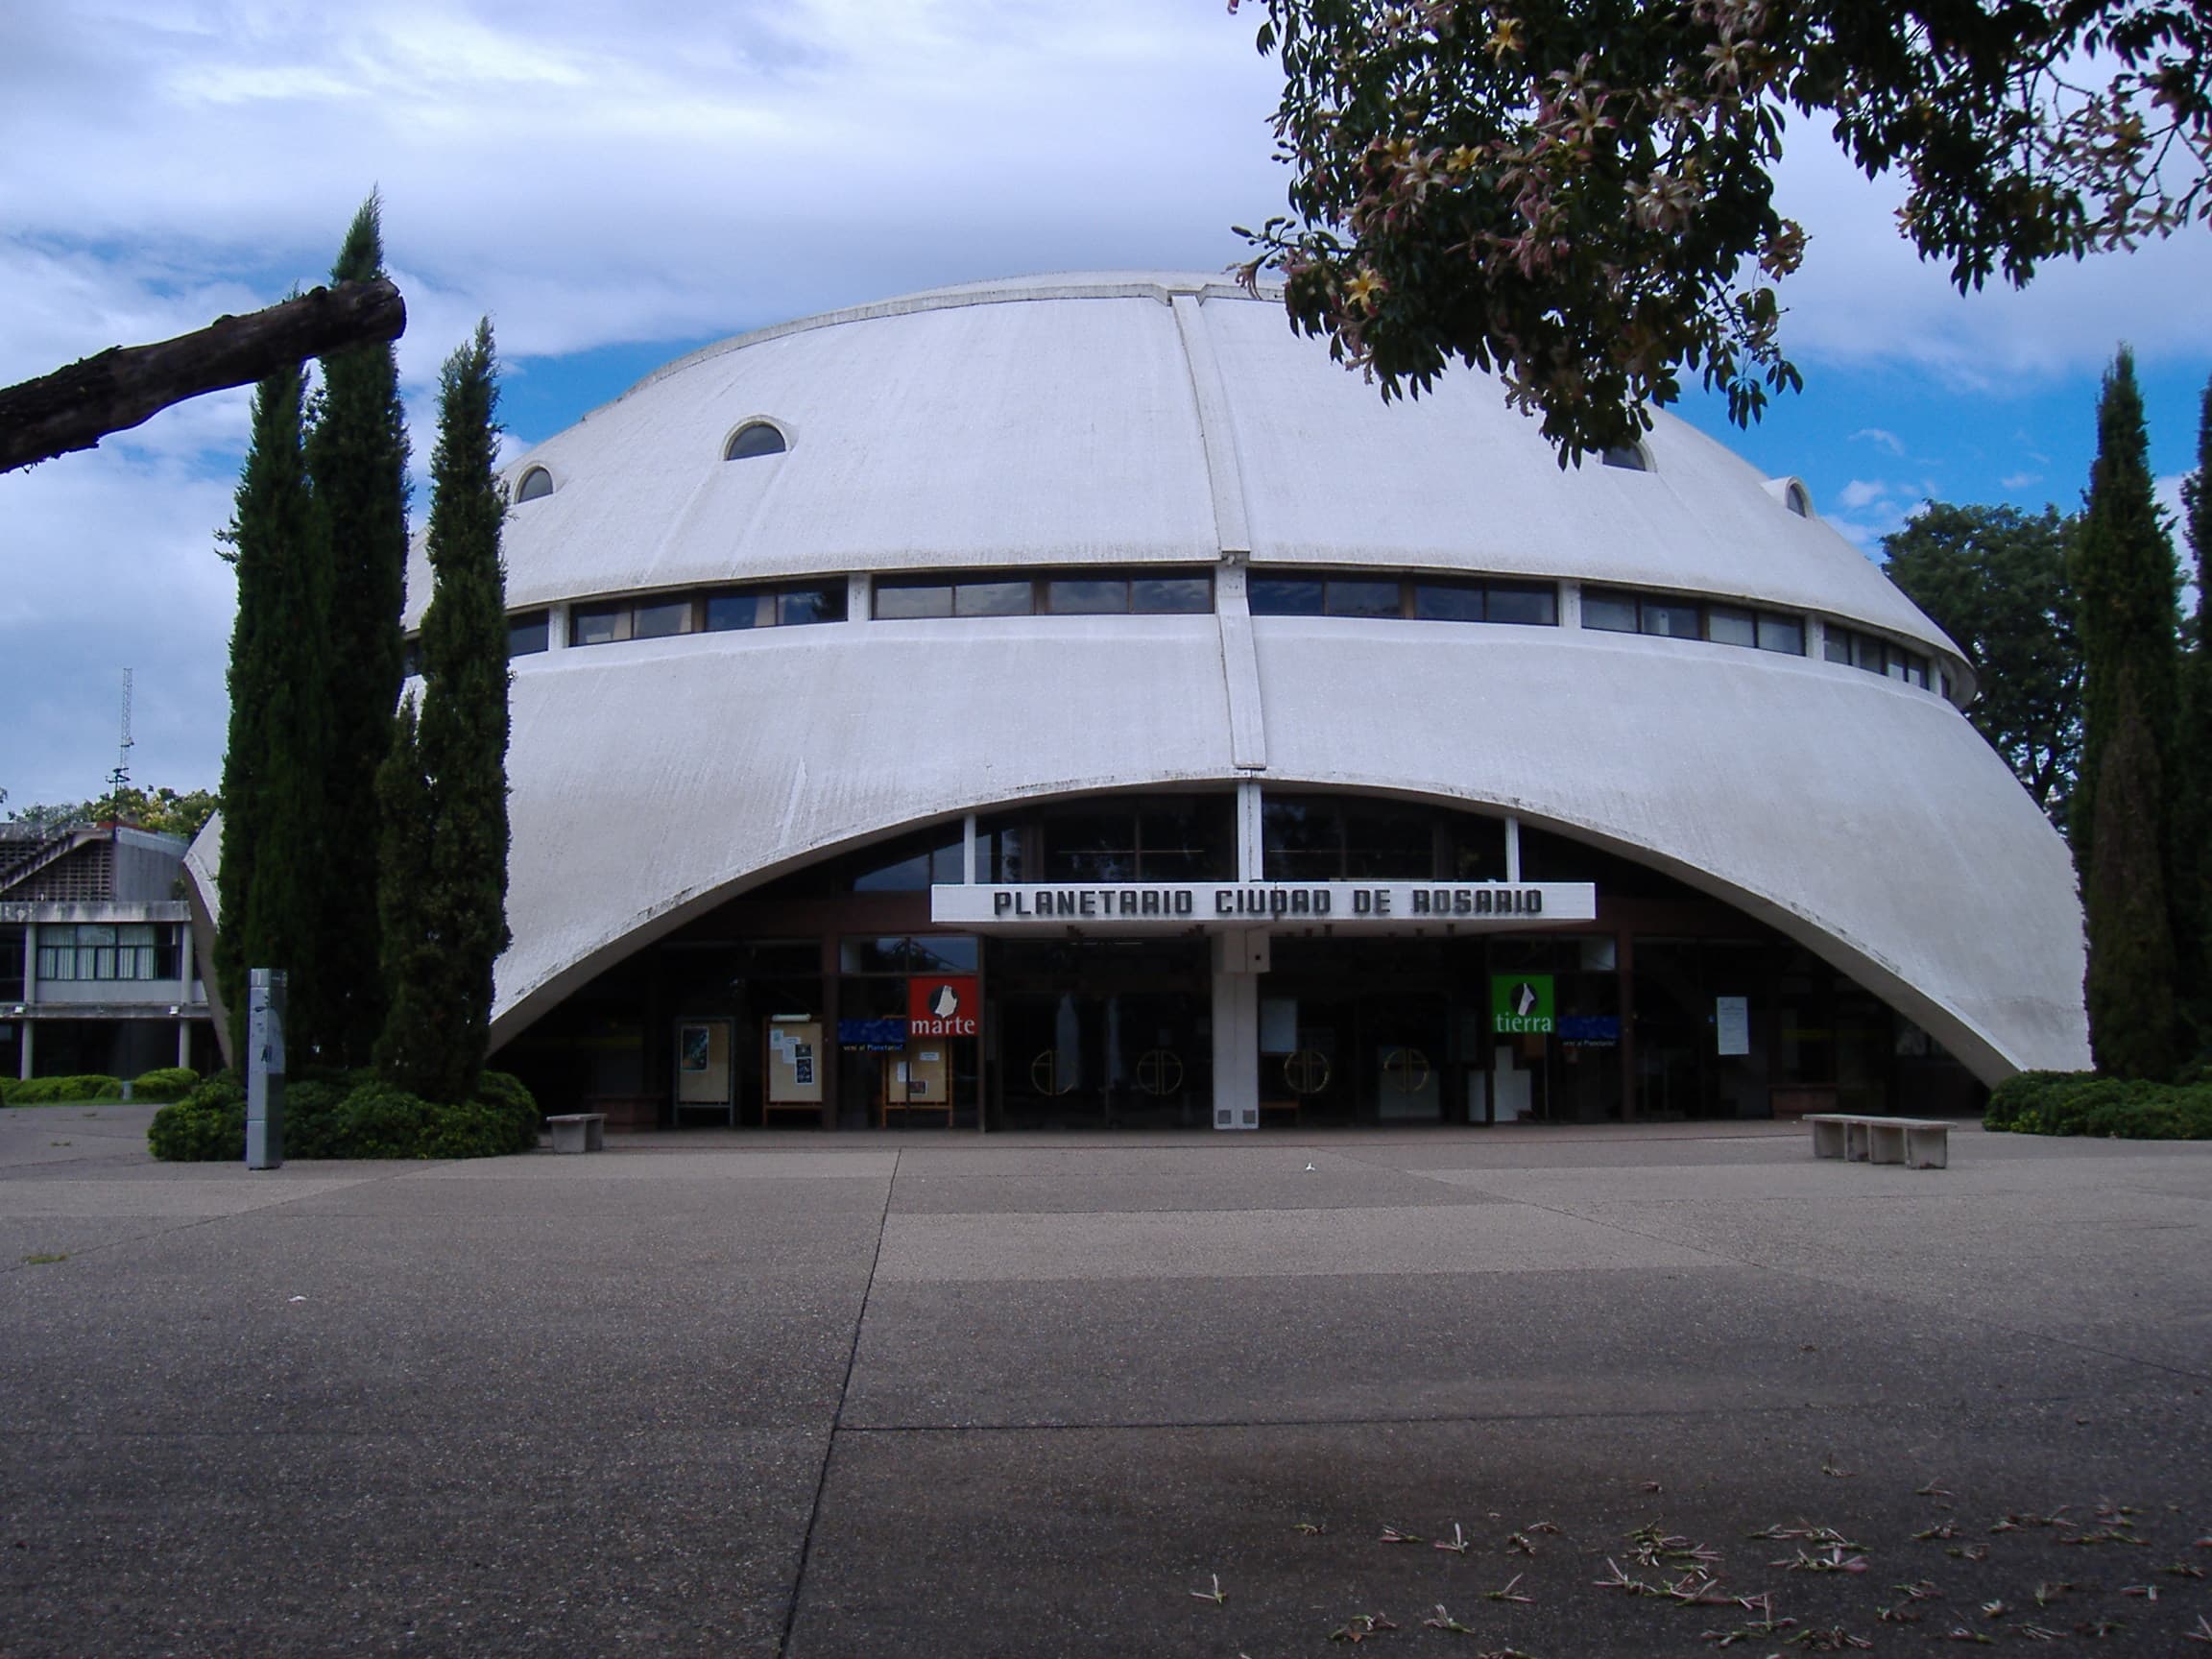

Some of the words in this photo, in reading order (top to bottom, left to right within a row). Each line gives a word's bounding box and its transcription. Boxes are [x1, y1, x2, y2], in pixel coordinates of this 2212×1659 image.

[995, 890, 1193, 915] PLANETARIO
[1215, 889, 1331, 914] CIUDAD
[1354, 889, 1391, 913] DE
[1413, 889, 1543, 913] ROSARIO
[912, 1016, 975, 1035] marte
[1496, 1014, 1551, 1033] tierra
